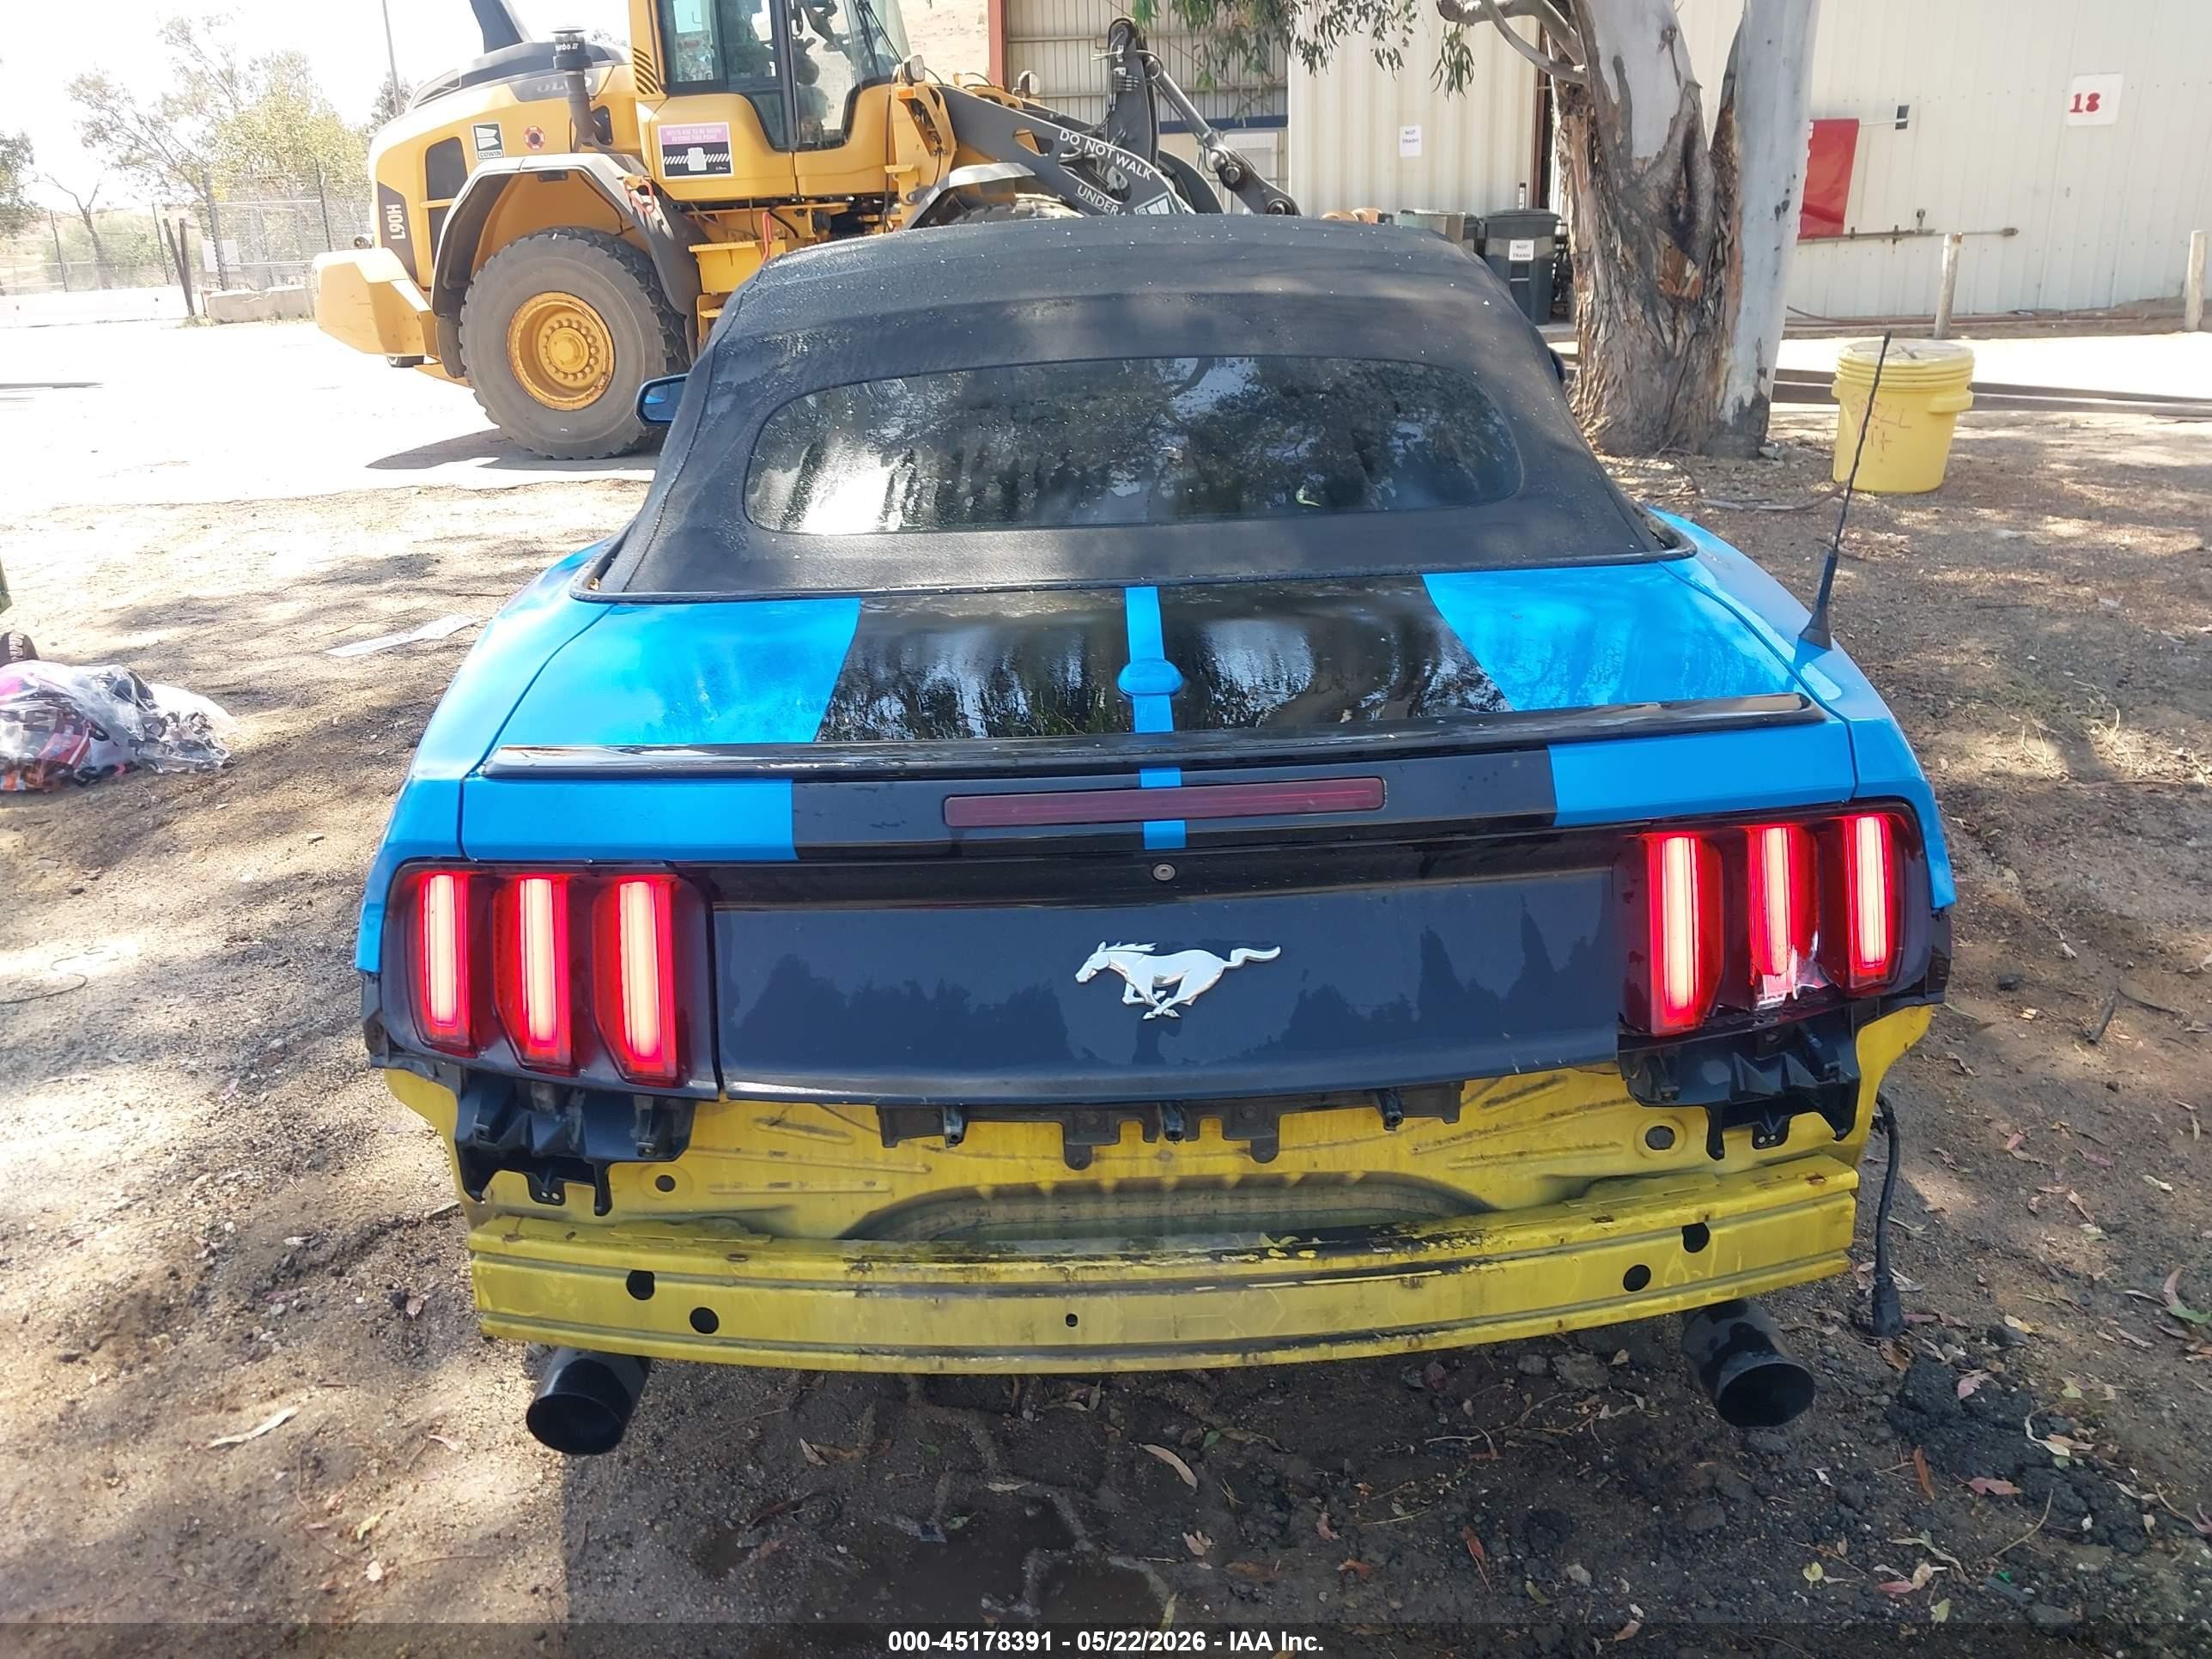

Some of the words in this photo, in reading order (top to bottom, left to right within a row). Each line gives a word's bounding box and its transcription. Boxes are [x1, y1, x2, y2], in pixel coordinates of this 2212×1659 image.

[2069, 92, 2101, 112] 18
[1059, 130, 1080, 145] DO
[1085, 138, 1115, 159] NOT
[1116, 152, 1152, 180] WALK
[1077, 185, 1119, 215] UNDER
[386, 204, 406, 240] L90H
